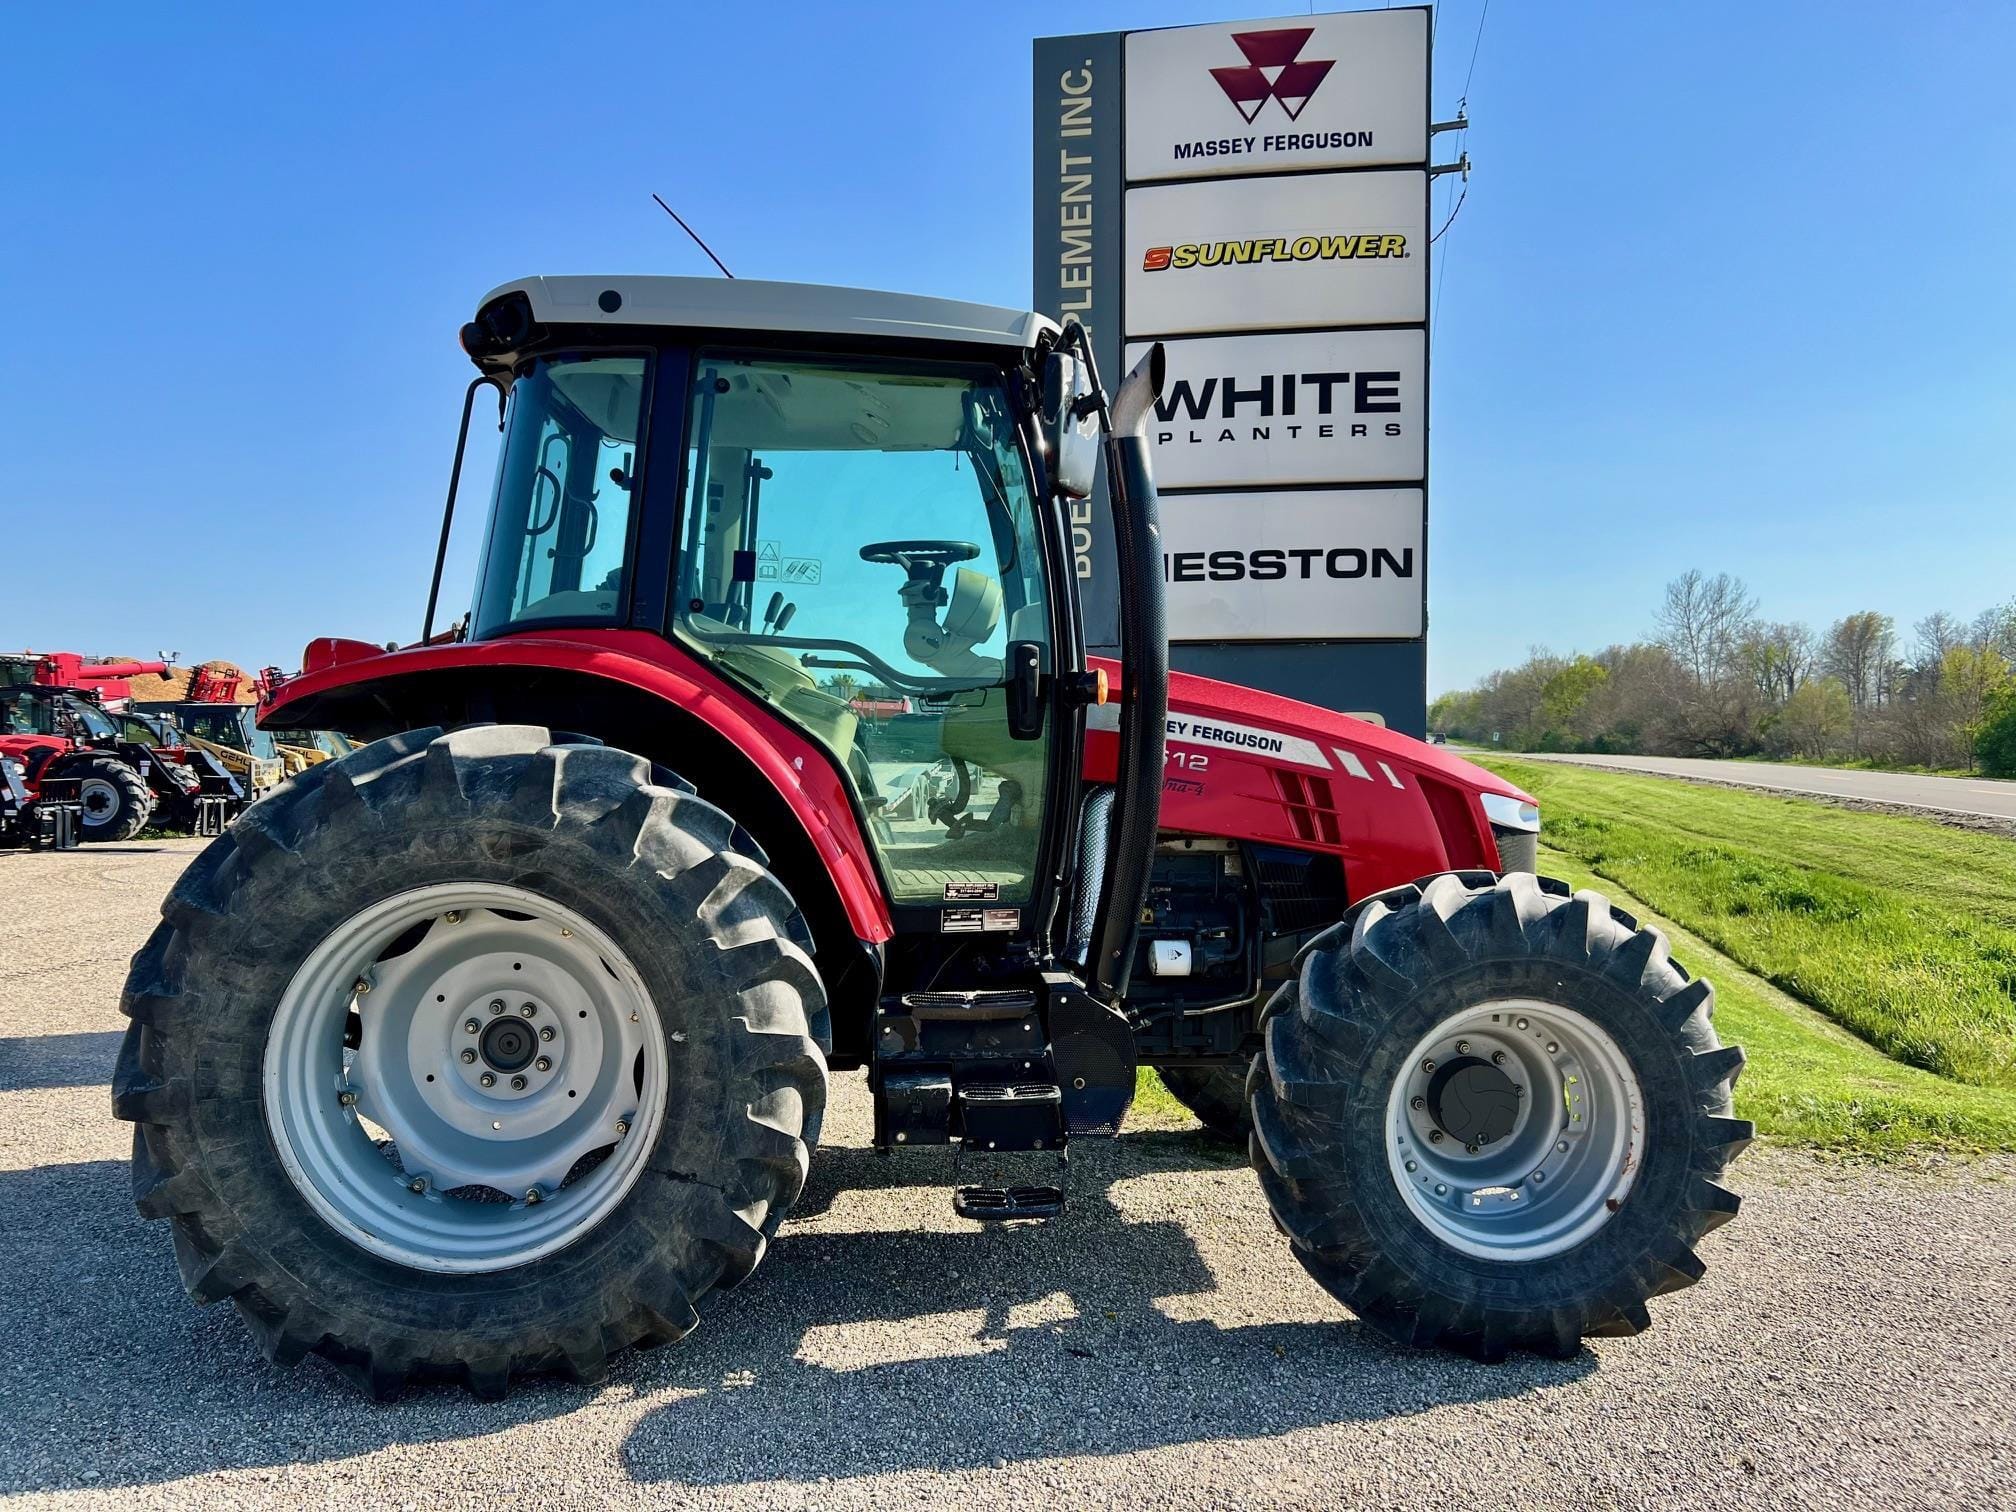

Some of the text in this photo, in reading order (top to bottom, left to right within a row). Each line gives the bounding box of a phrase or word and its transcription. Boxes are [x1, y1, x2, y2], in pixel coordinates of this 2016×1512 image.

[1061, 59, 1092, 137] INC.
[1174, 131, 1373, 159] MASSEY FERGUSON
[1154, 371, 1401, 422] WHITE
[1158, 423, 1401, 445] PLANTERS
[1192, 724, 1283, 752] FERGUSON
[220, 750, 249, 767] GEHL
